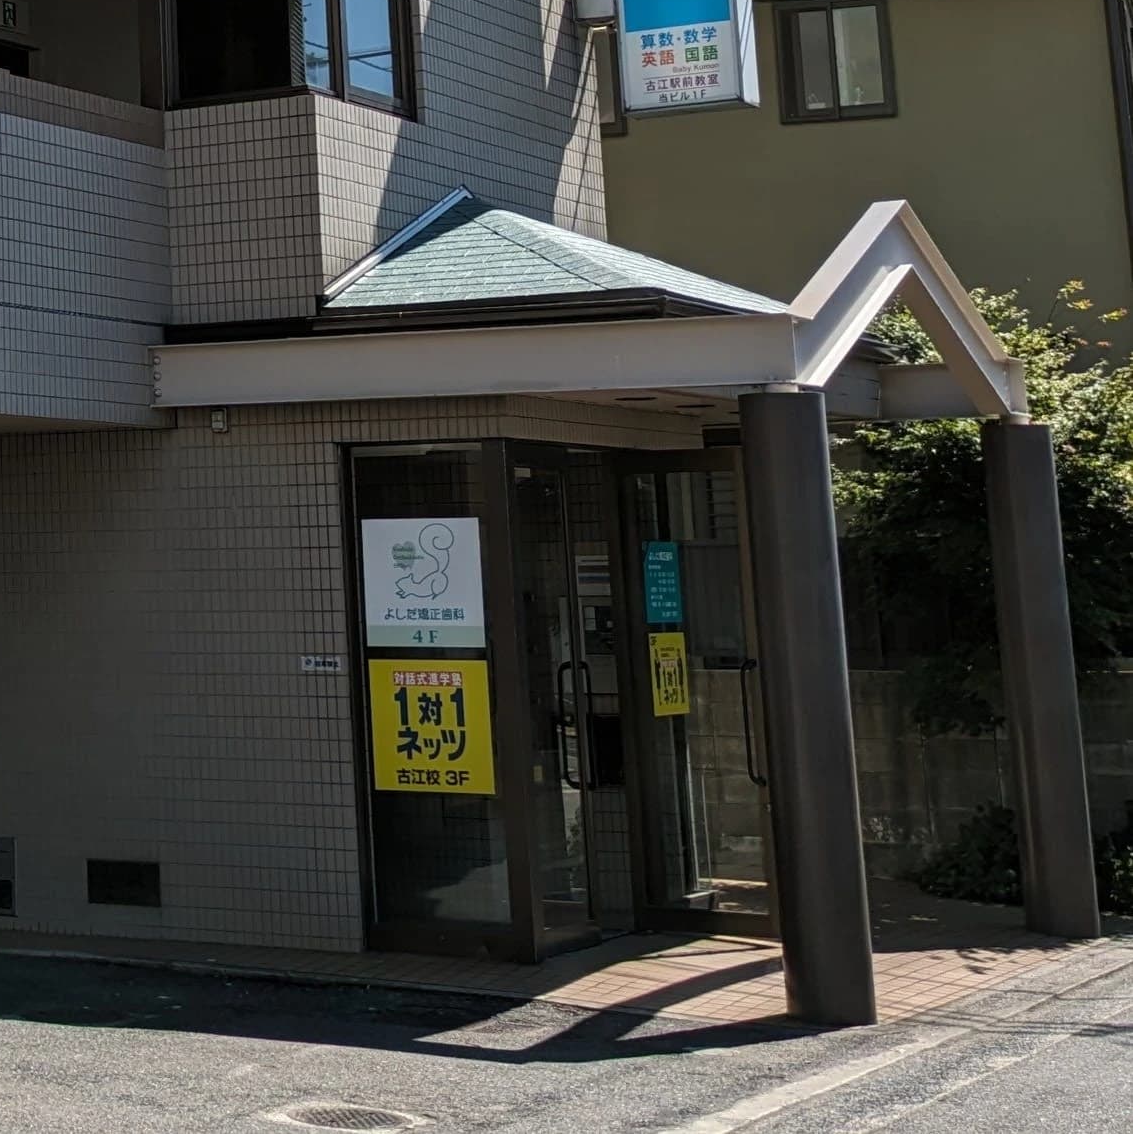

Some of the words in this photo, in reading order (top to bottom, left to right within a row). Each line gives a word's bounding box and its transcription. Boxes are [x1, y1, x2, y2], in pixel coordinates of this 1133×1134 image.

[641, 49, 675, 67] 英語
[684, 44, 719, 63] 国語
[644, 73, 719, 92] 古江駅前教室
[384, 607, 465, 621] よしだ矯正歯科
[393, 671, 463, 687] 対話式進学塾
[394, 687, 466, 728] 1対1
[396, 727, 467, 762] ネッツ
[396, 768, 442, 786] 古江校
[445, 769, 471, 787] 3F
